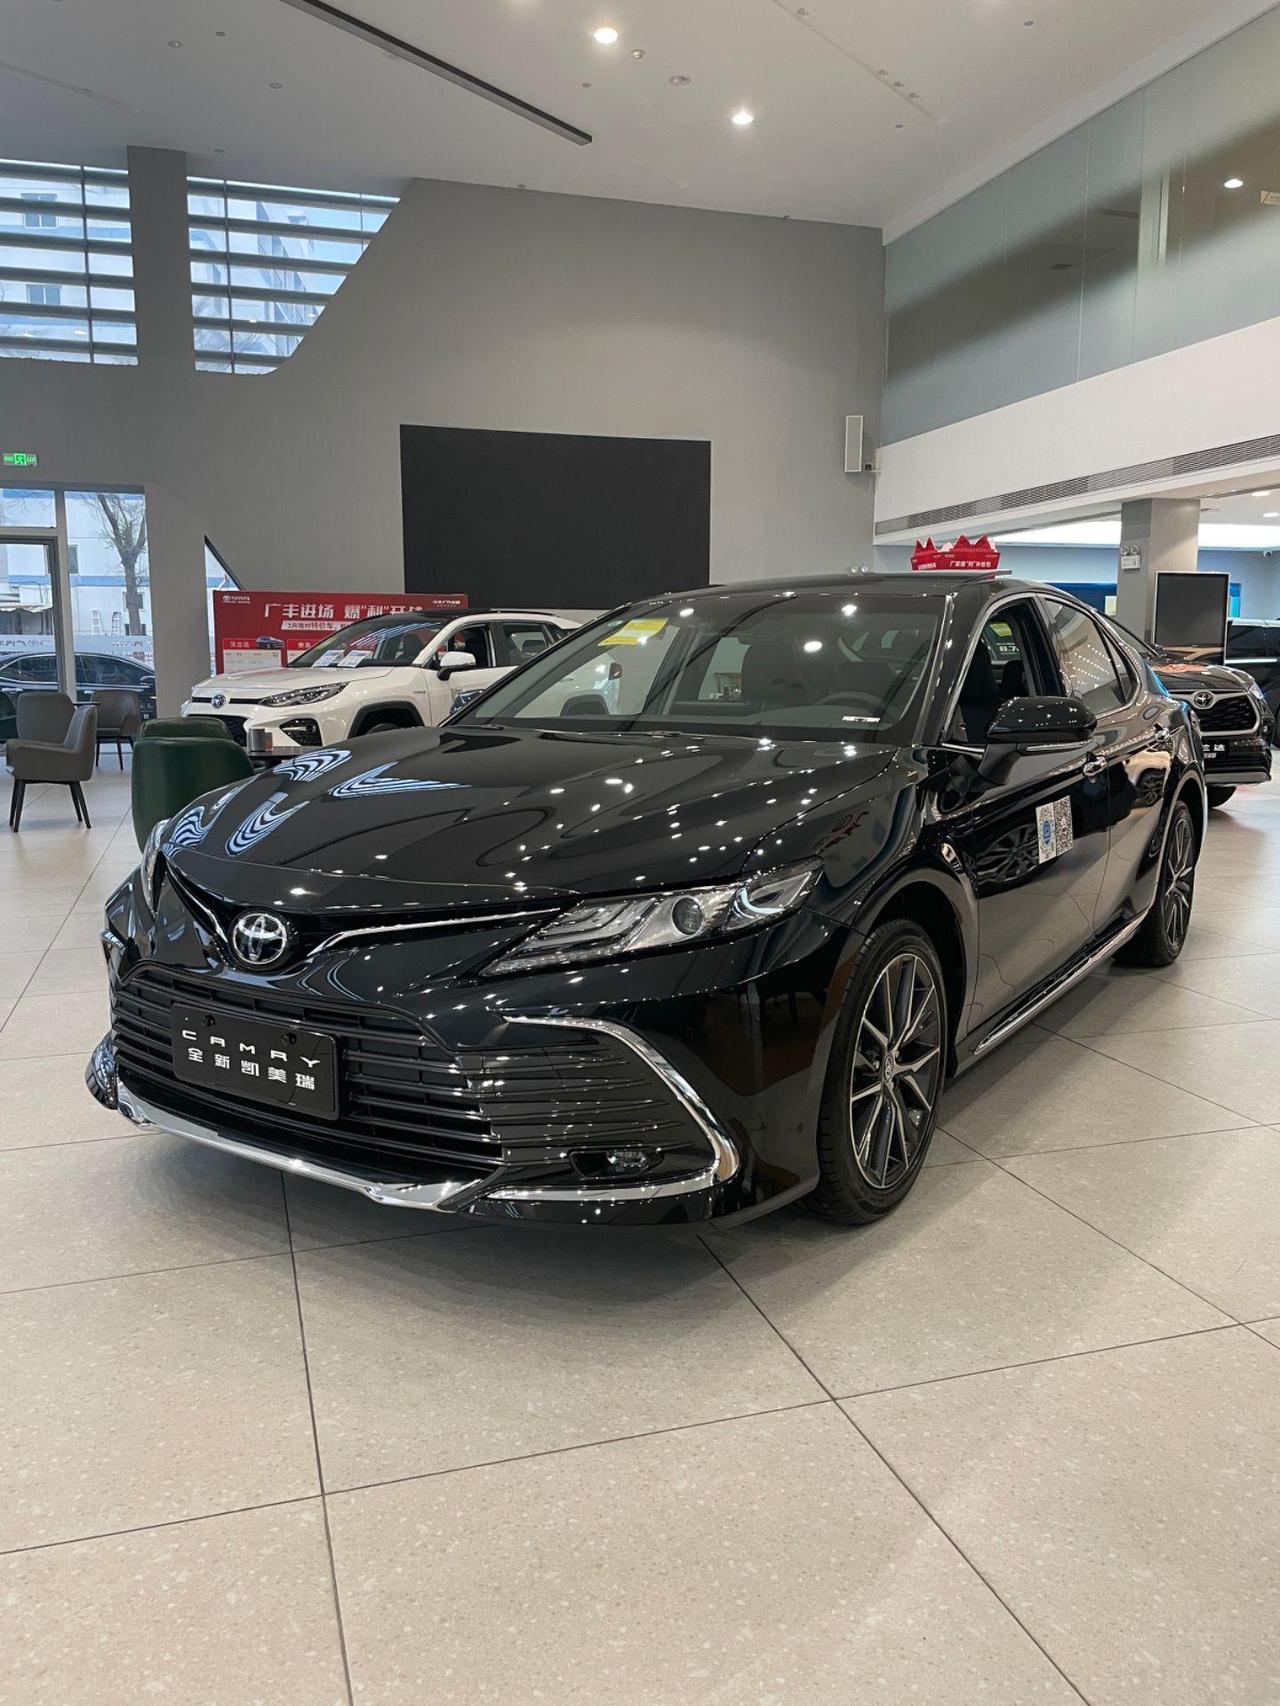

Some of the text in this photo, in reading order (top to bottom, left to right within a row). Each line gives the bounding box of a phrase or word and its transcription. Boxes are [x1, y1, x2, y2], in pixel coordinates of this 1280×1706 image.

[264, 603, 334, 619] 广丰进场
[182, 1029, 321, 1069] CAMRY
[188, 1047, 315, 1090] 全新凯美瑞
